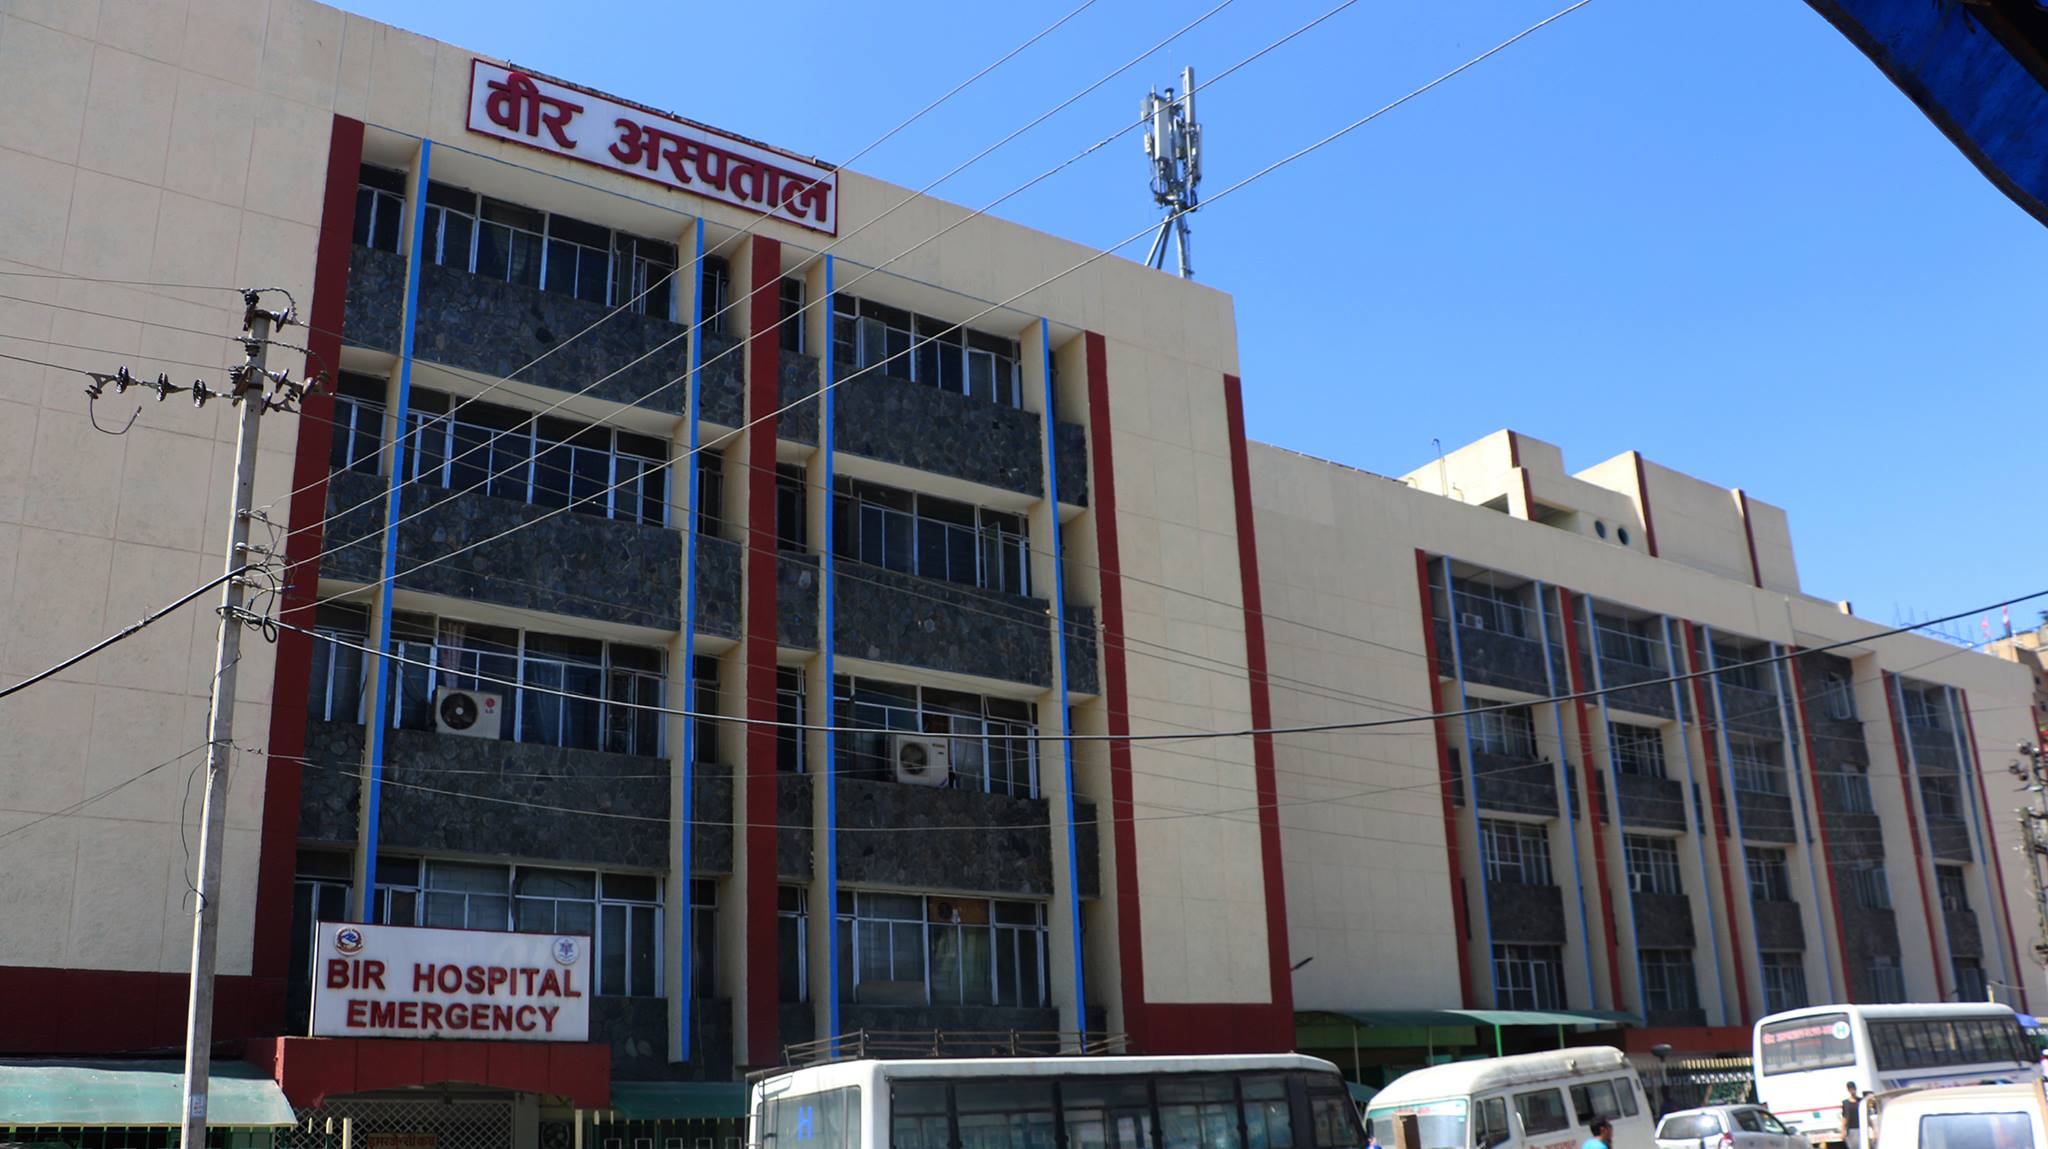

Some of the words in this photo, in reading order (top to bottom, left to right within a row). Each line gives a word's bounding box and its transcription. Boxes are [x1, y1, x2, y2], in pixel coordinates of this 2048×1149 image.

[486, 71, 584, 149] वीर
[608, 118, 832, 222] अस्पताल
[326, 959, 386, 990] BIR
[413, 963, 582, 998] HOSPITAL
[346, 1000, 560, 1033] EMERGENCY
[798, 1105, 814, 1140] H
